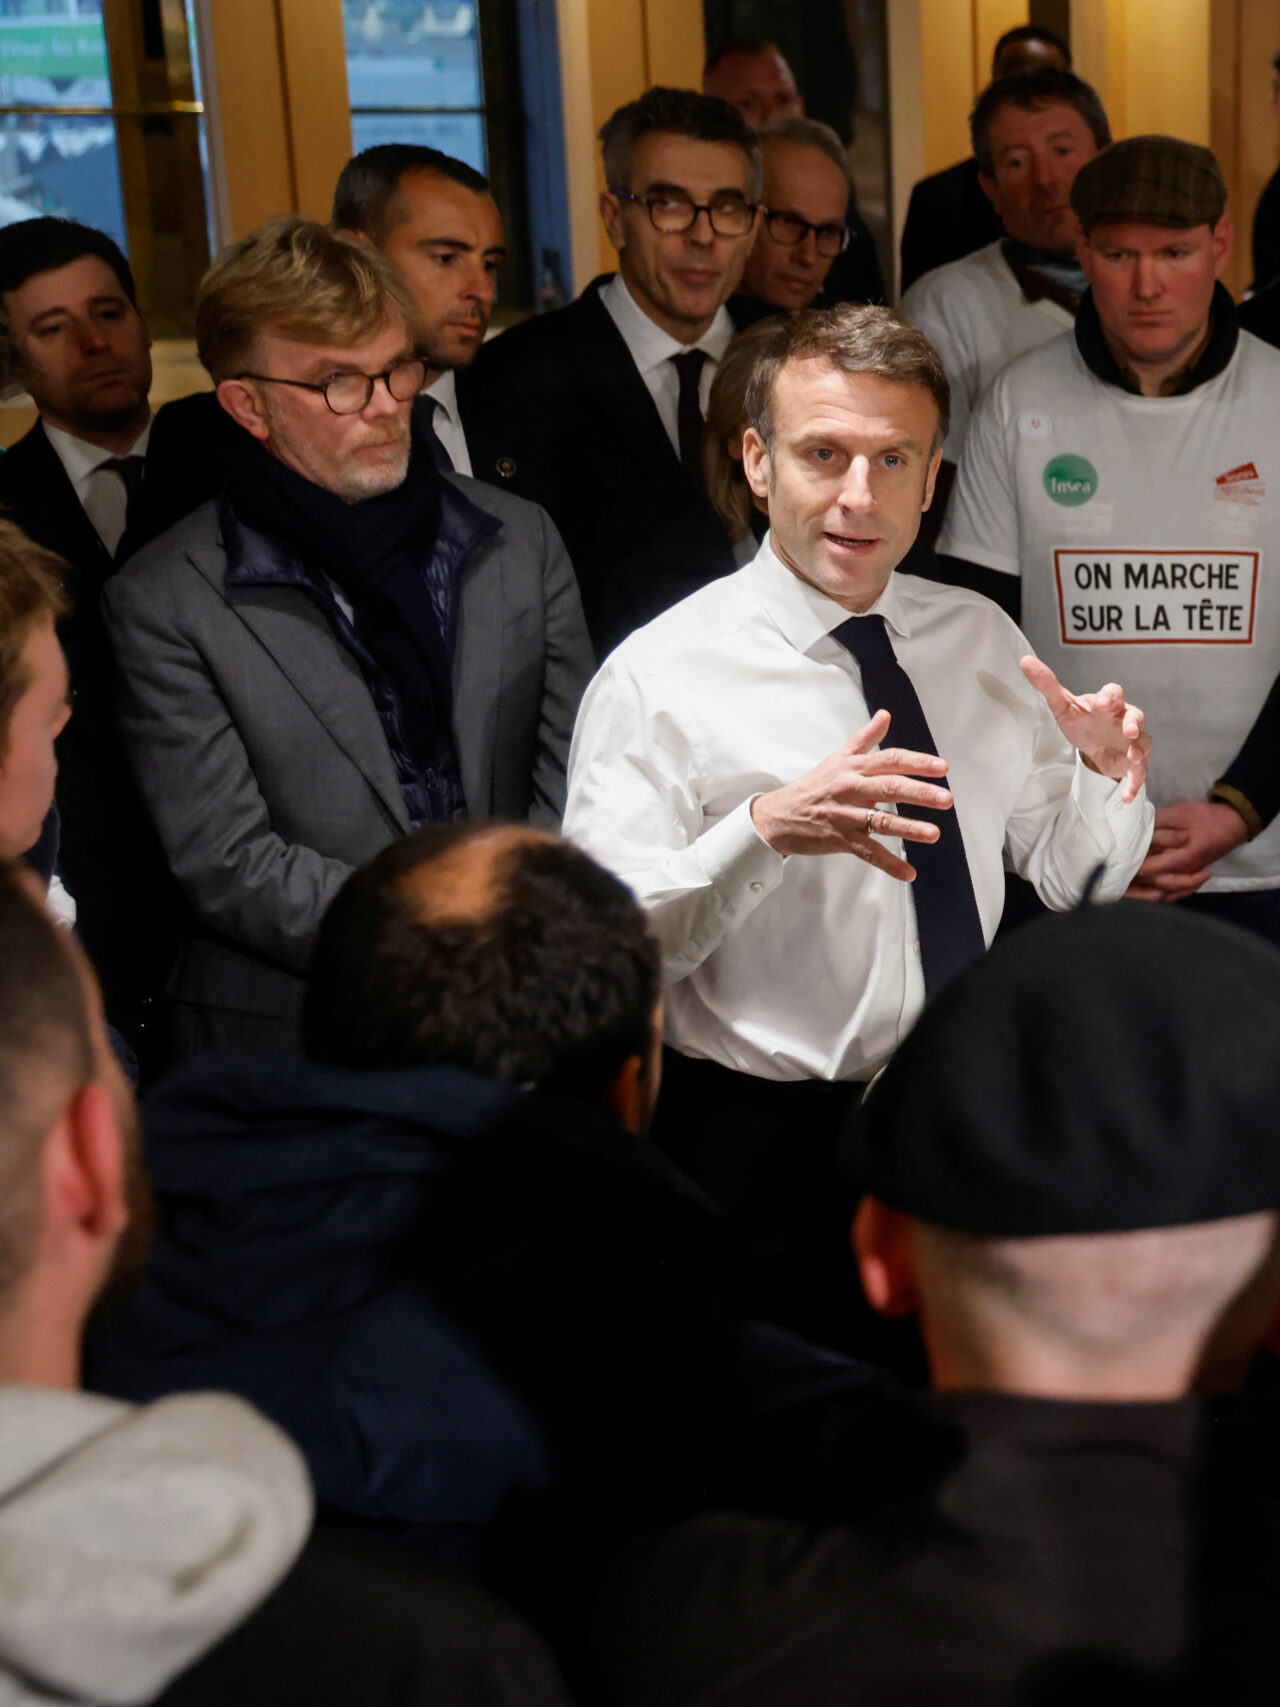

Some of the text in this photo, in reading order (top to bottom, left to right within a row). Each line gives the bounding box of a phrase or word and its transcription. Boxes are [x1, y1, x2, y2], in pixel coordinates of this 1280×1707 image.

[1074, 563, 1240, 589] ON MARCHE
[1071, 598, 1243, 631] SUR LA TÊTE
